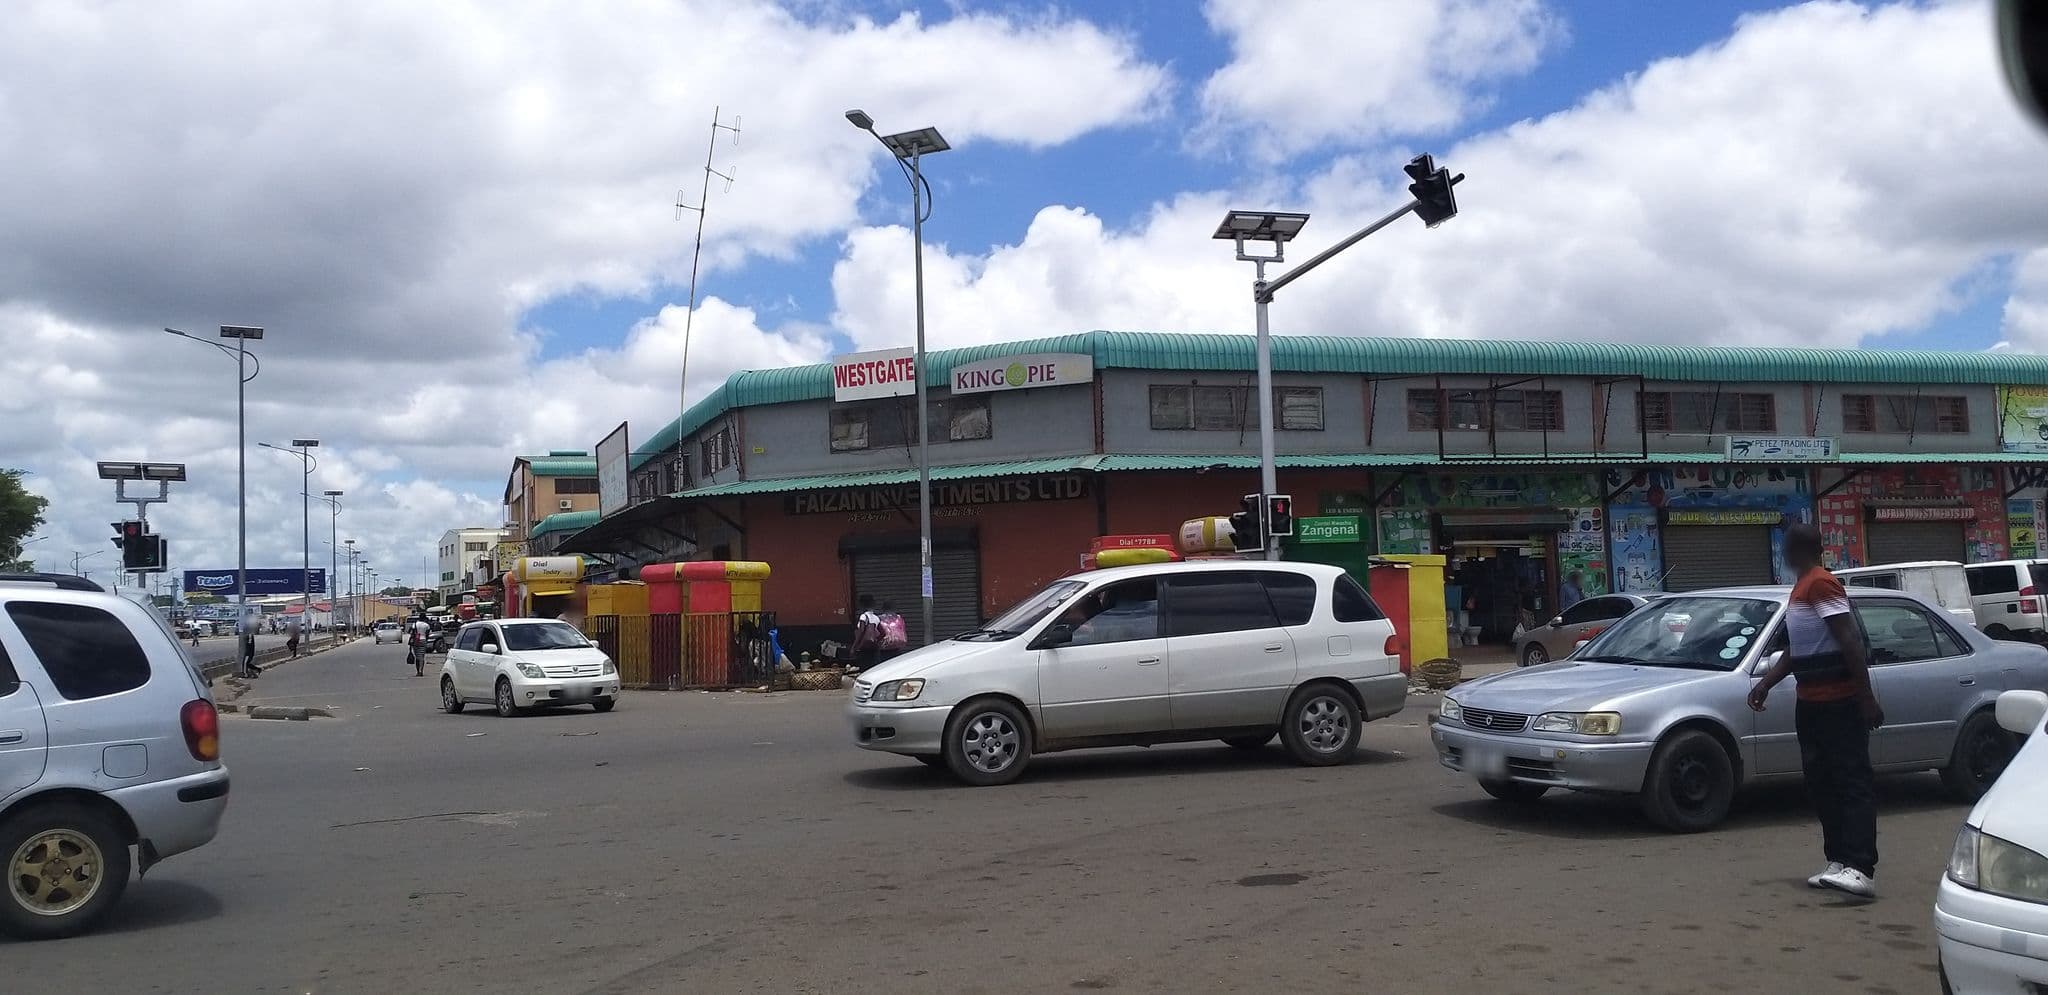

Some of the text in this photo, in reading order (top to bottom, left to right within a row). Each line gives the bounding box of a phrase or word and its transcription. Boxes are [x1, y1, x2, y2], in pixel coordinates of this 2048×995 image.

[834, 357, 914, 389] WESTGATE
[957, 363, 1057, 390] KING PIE
[1780, 439, 1811, 448] TRADING
[794, 489, 866, 514] FAIZAN
[870, 479, 1031, 511] INVETMENTS
[1301, 523, 1359, 538] Zangena!
[1119, 538, 1134, 546] Dial
